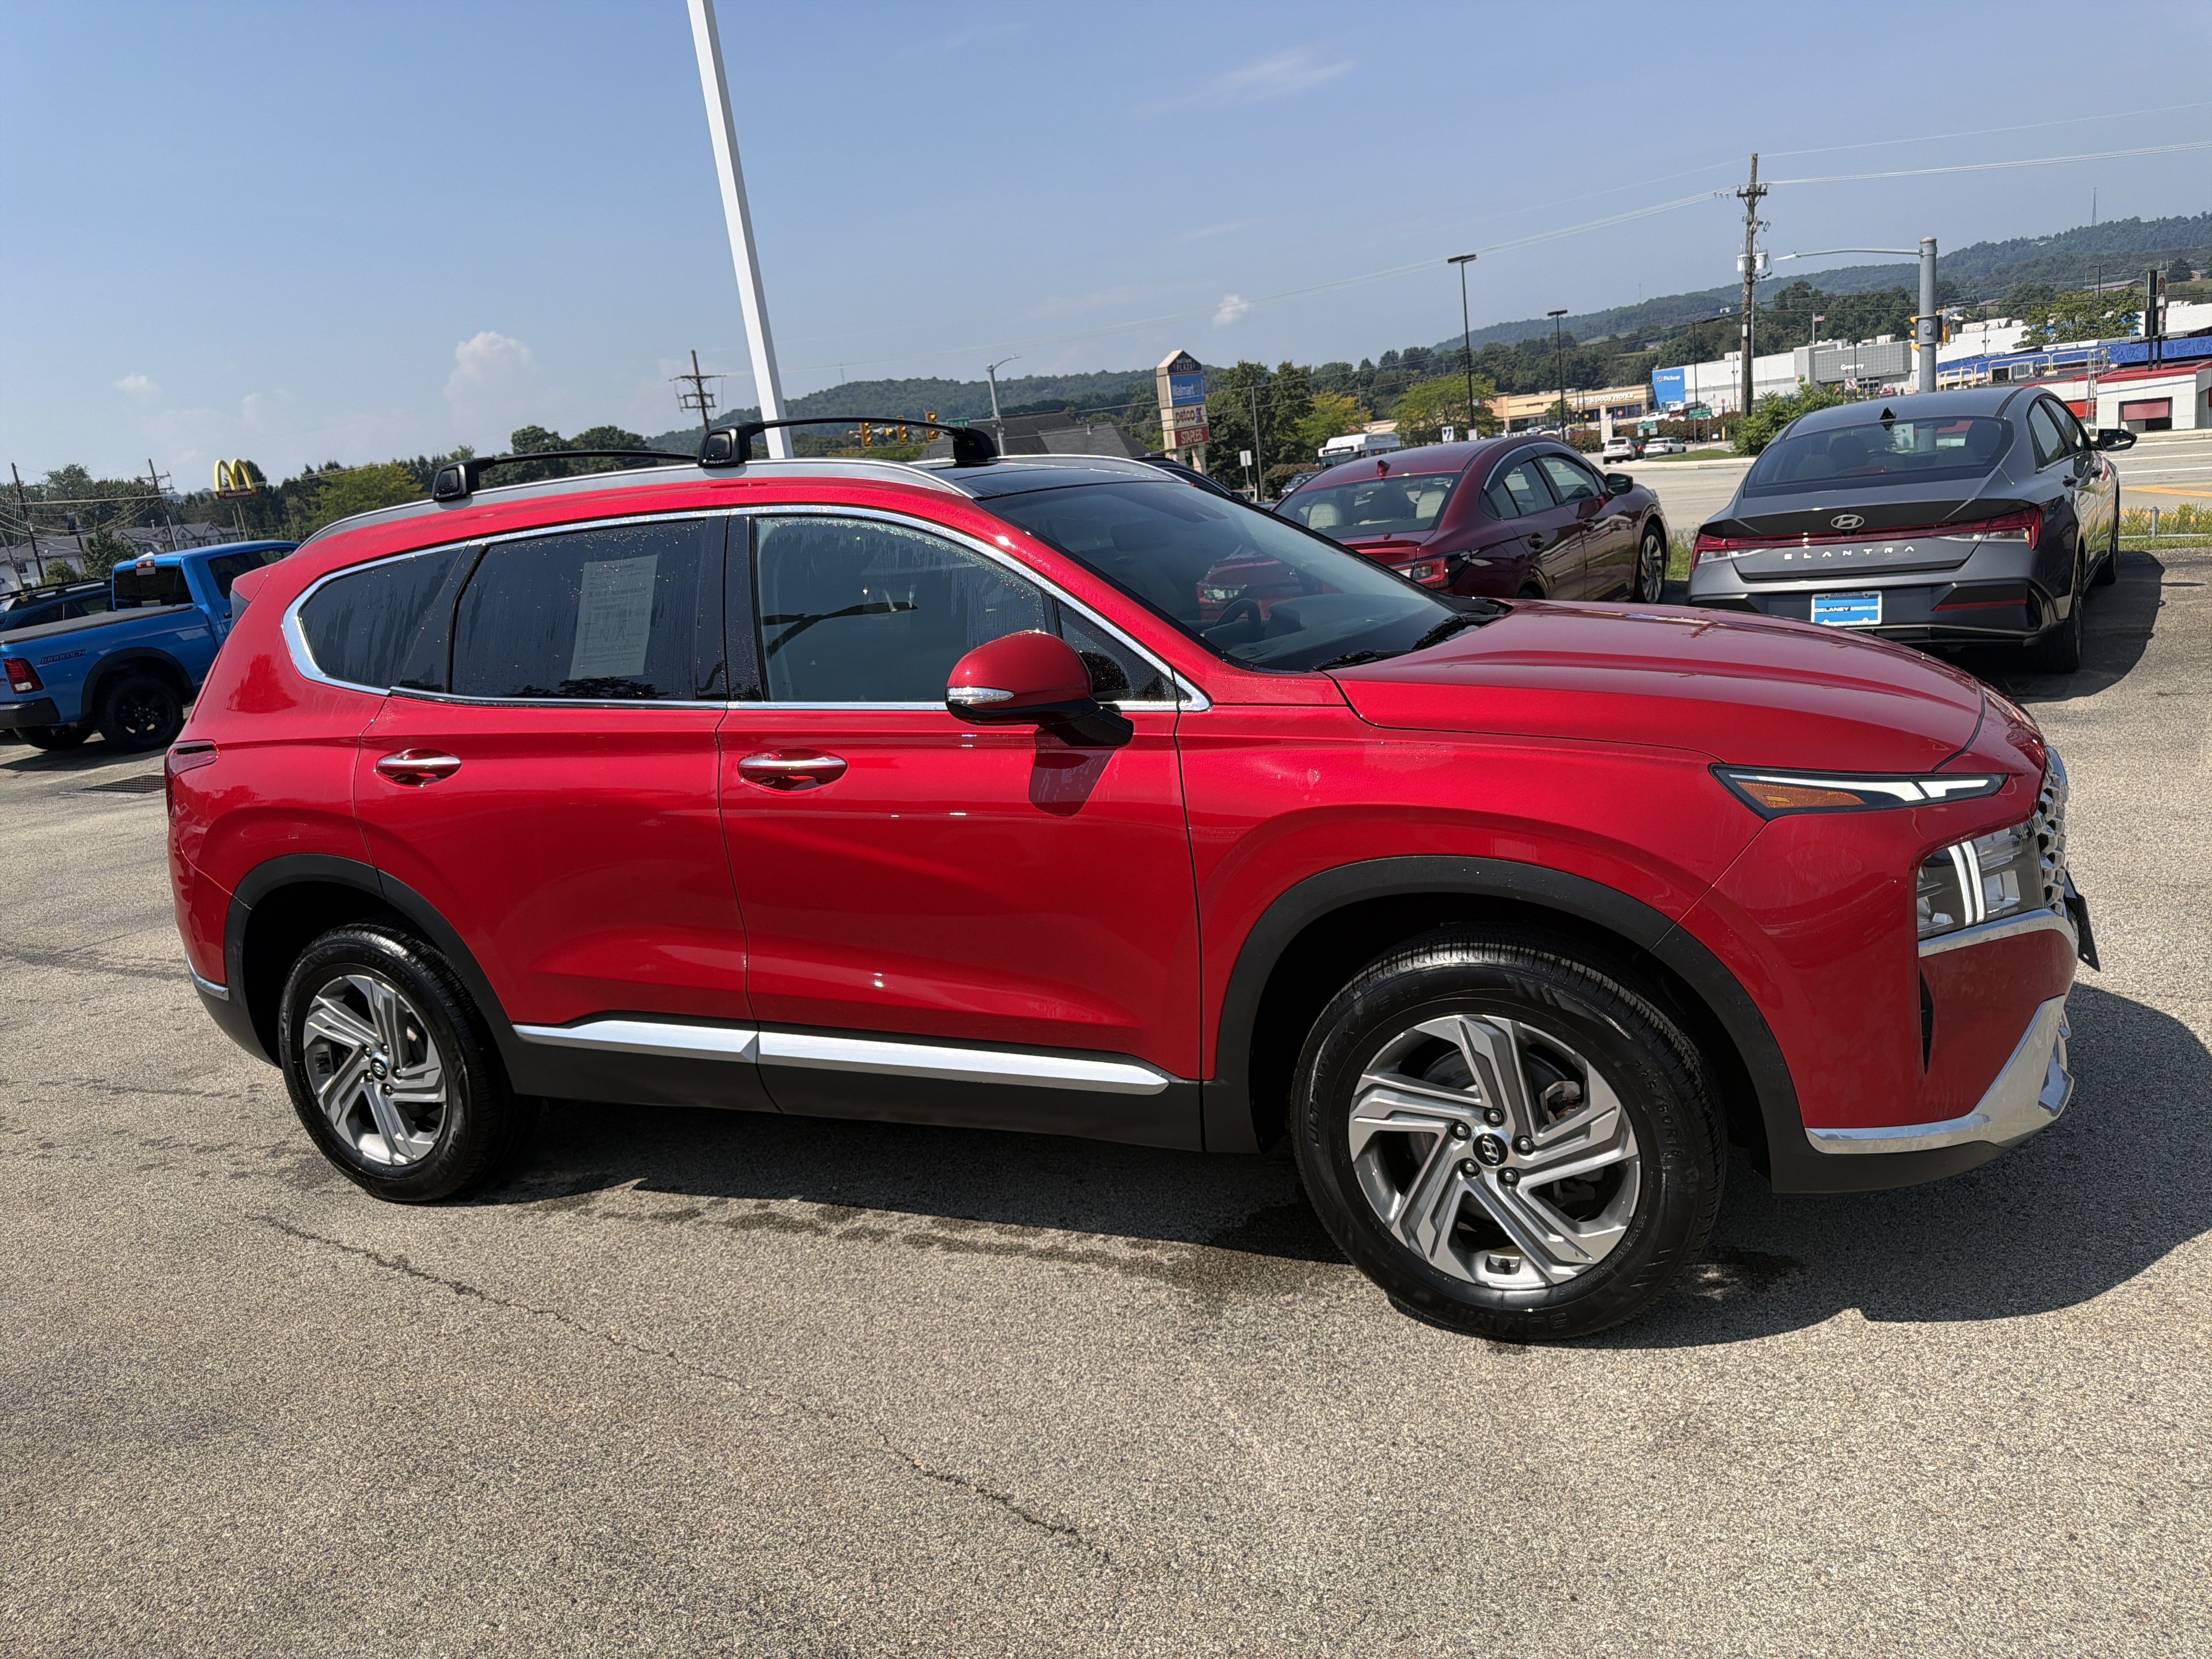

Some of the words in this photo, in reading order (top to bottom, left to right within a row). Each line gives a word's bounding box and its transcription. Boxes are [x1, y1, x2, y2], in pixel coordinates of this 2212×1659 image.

[1172, 383, 1195, 397] Walmart
[1613, 392, 1633, 400] Works
[1176, 409, 1195, 426] petco
[1181, 428, 1203, 444] STAPLES
[1784, 546, 1914, 560] ELANTRA
